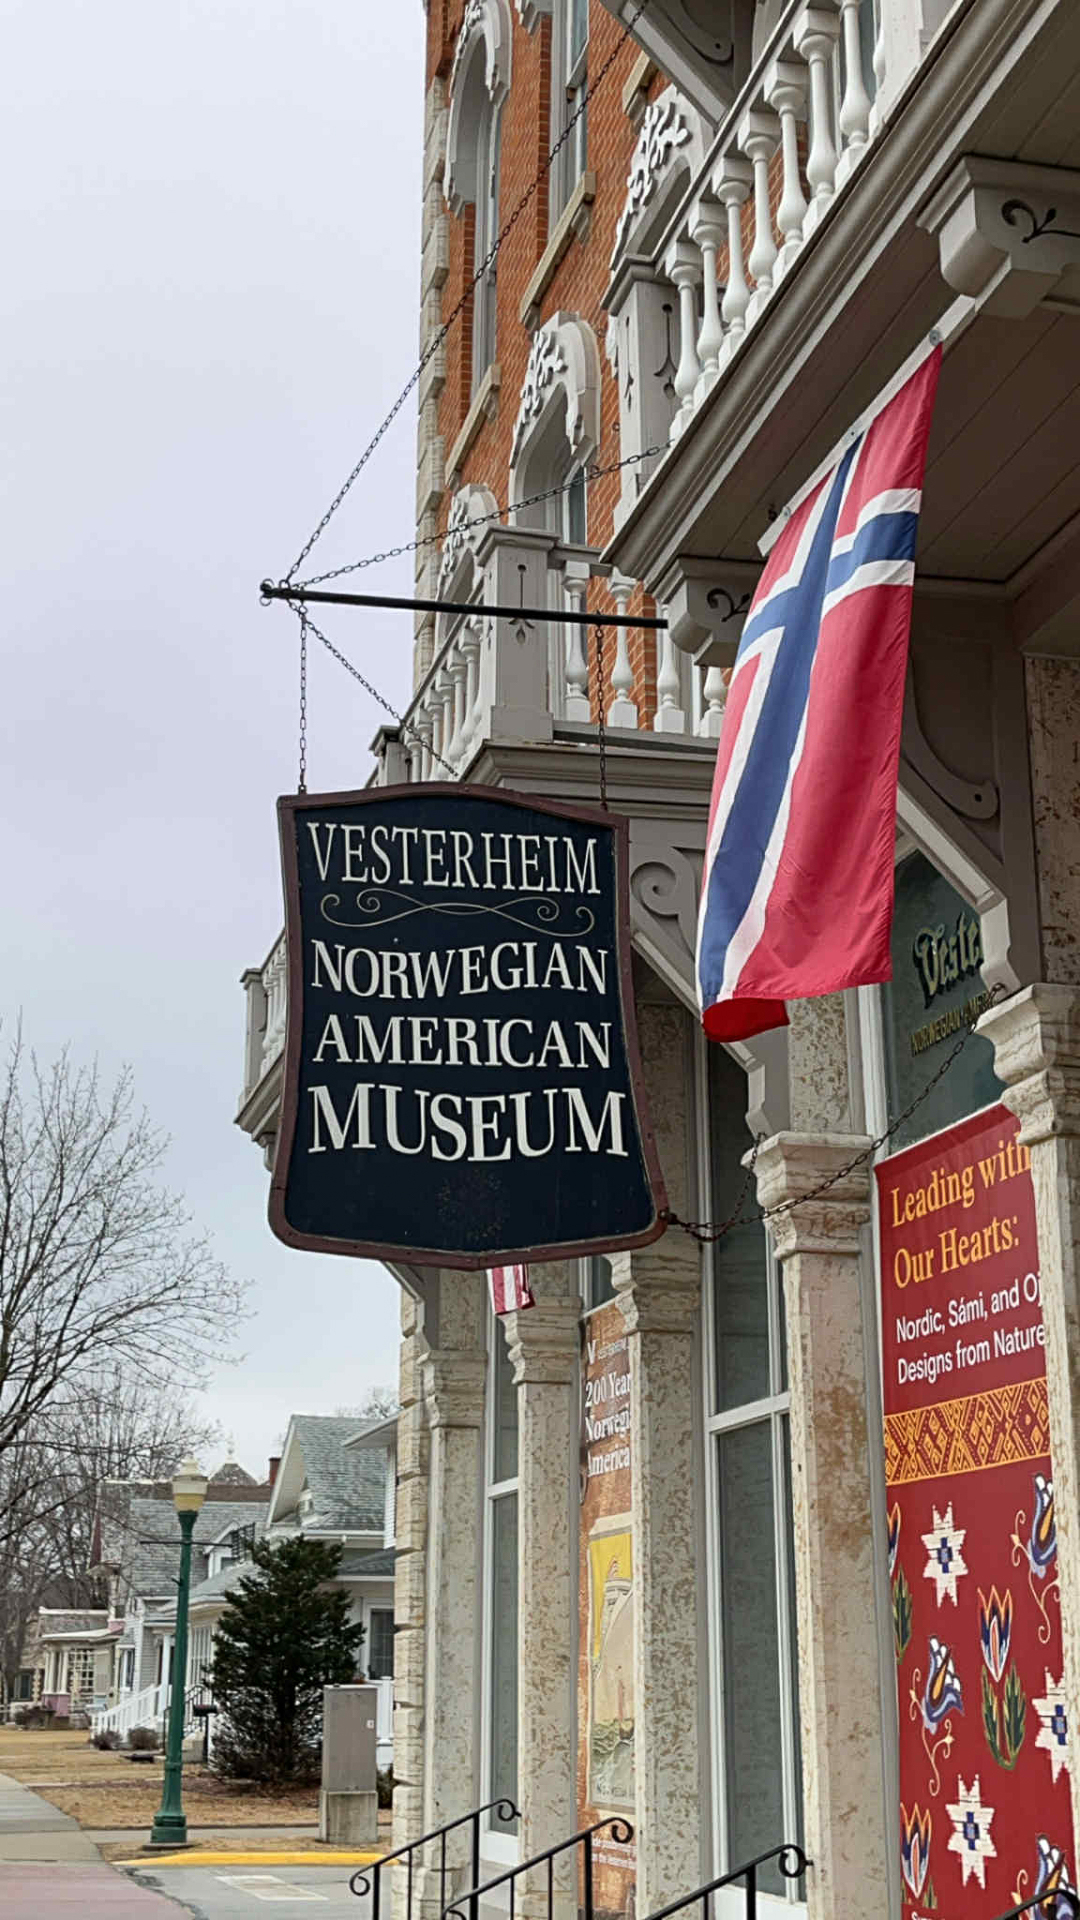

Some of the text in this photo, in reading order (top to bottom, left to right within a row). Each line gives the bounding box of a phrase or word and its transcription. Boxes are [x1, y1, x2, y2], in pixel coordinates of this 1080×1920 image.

[307, 822, 601, 895] VESTERHEIM
[311, 939, 608, 999] NORWEGIAN
[312, 1014, 612, 1069] AMERICAN
[307, 1083, 629, 1163] MUSEUM
[891, 1132, 1031, 1227] Leading with
[894, 1215, 1020, 1289] Our Hearts:
[896, 1307, 945, 1343] Nordic,
[948, 1291, 988, 1324] Sámi,
[991, 1280, 1020, 1316] and
[897, 1322, 1046, 1384] Designs from Nature
[585, 1377, 607, 1408] 200
